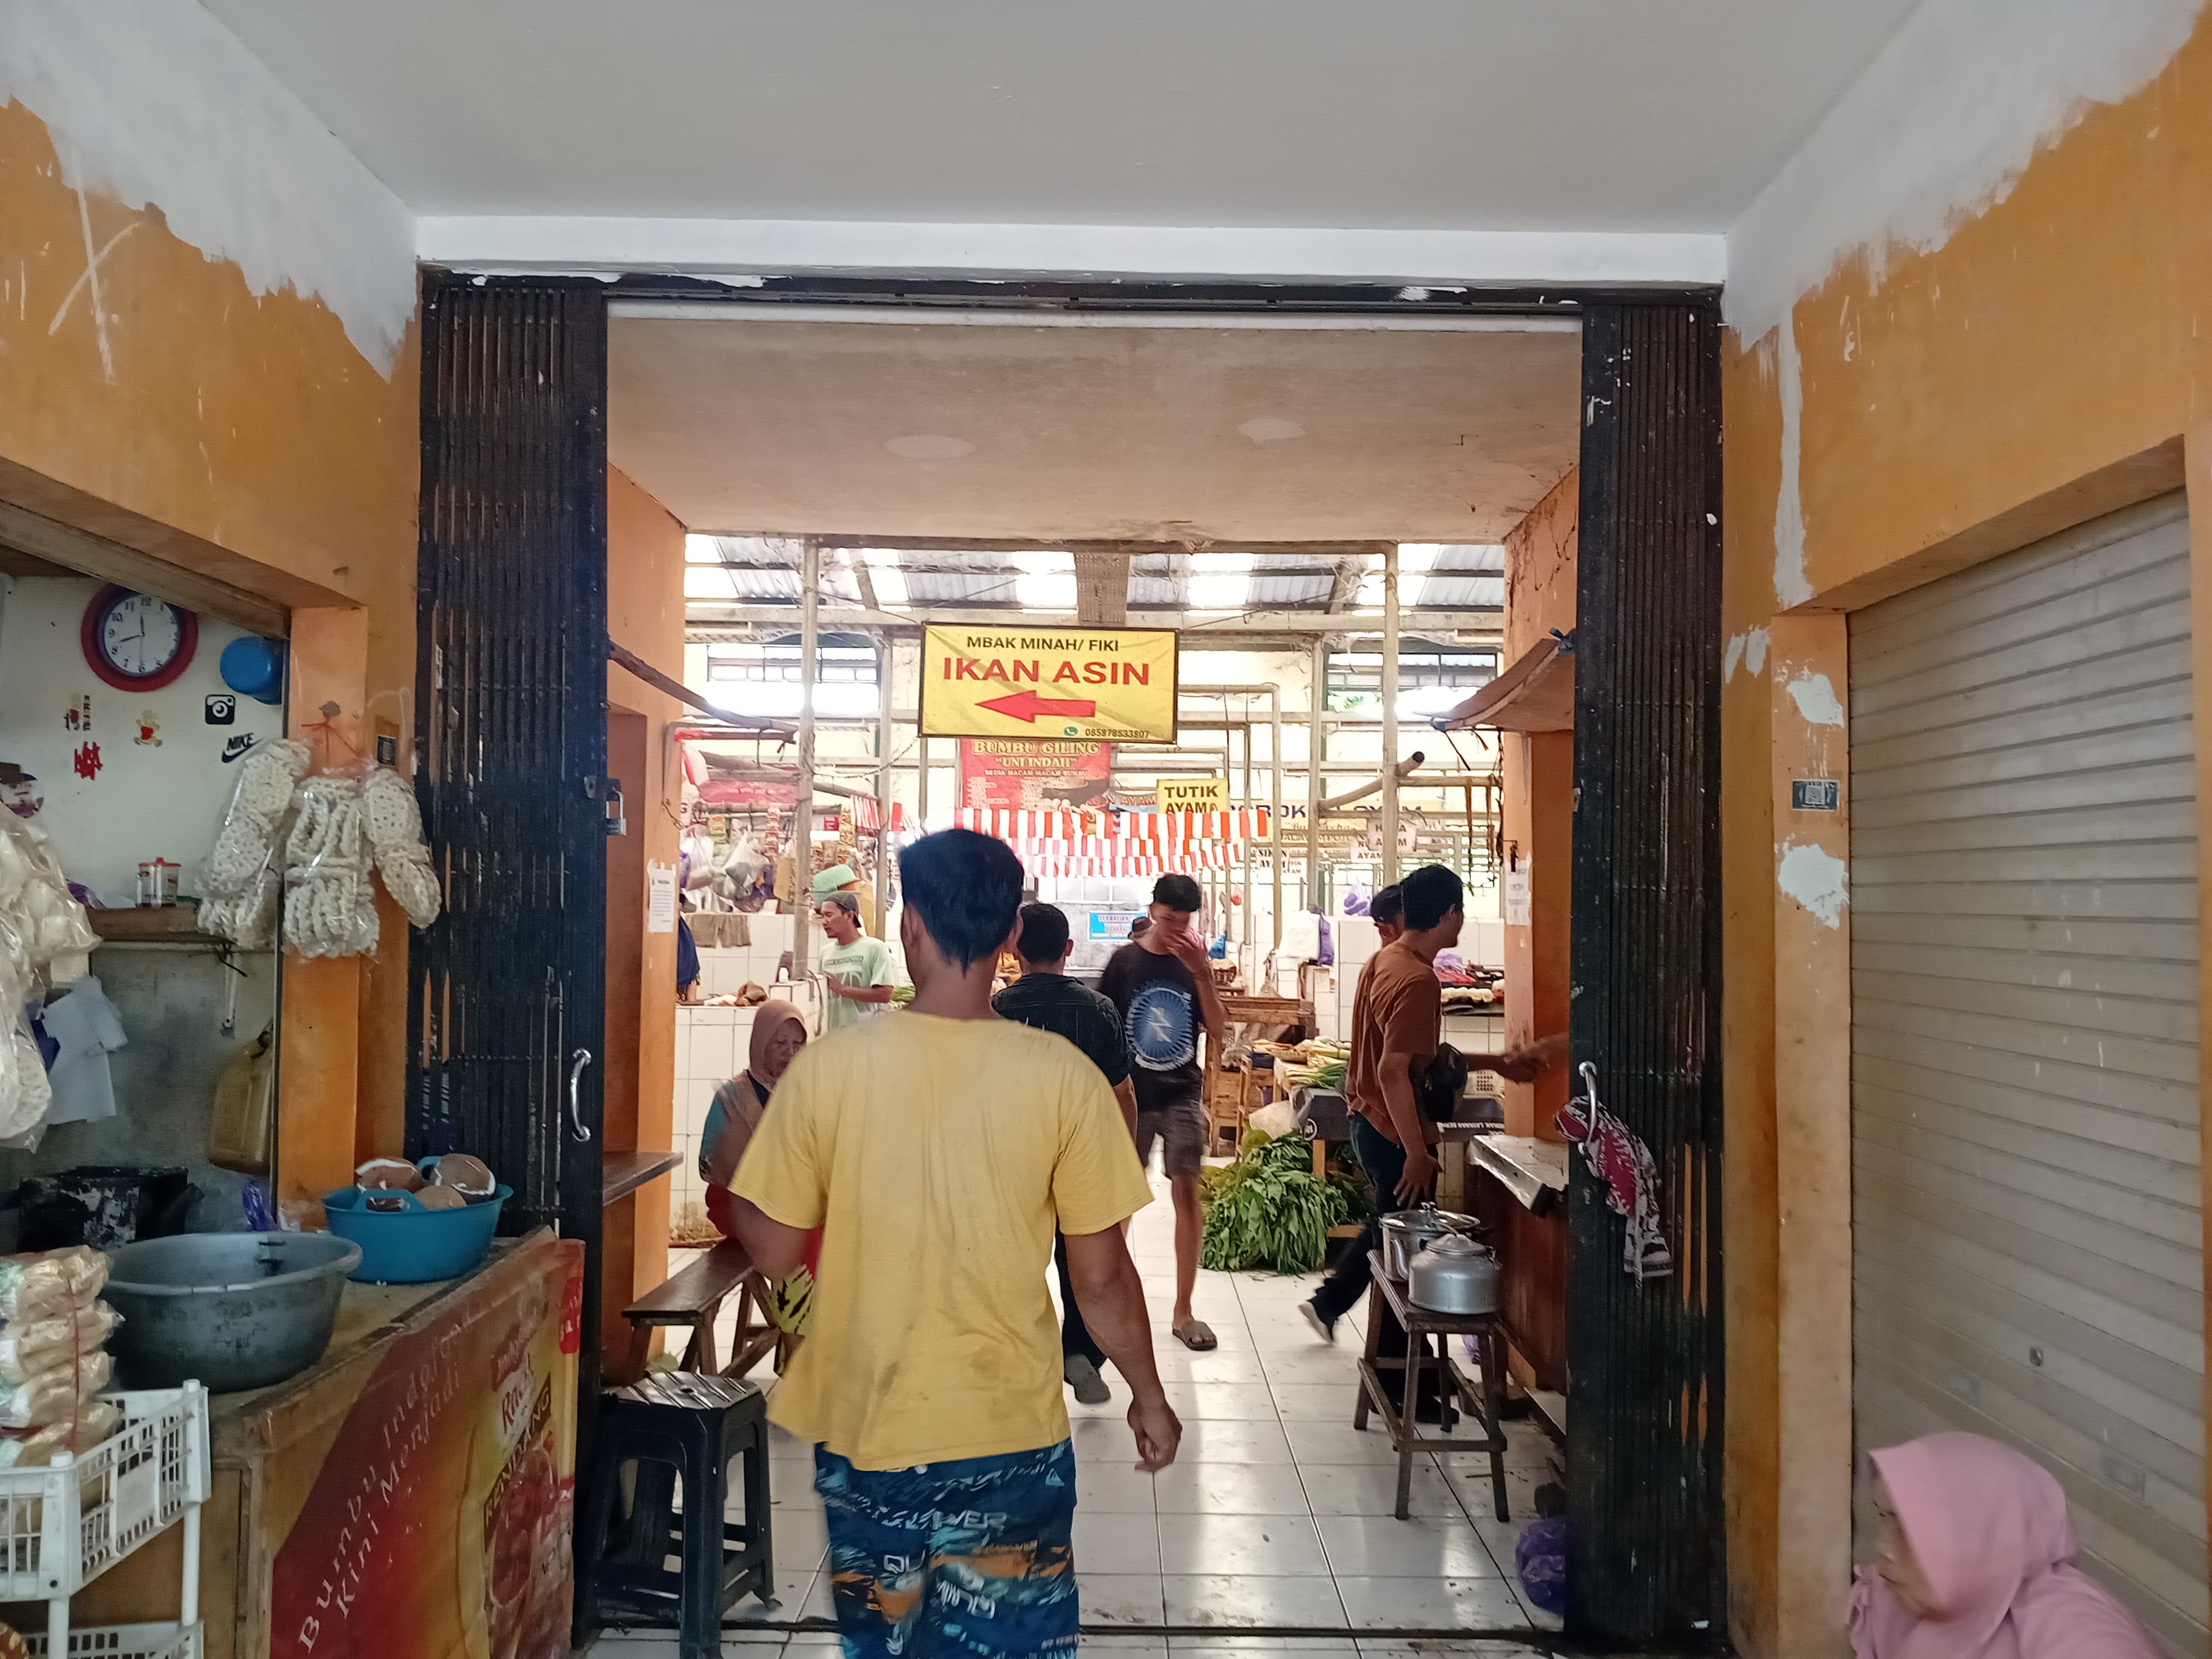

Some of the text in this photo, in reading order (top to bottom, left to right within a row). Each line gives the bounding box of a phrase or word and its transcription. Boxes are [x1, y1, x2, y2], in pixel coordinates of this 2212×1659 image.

[967, 636, 1119, 652] MBAK MINAH/ FIKI
[943, 657, 1149, 686] IKAN ASIN
[226, 732, 254, 751] NIKE
[972, 740, 1101, 756] BUMBU GILING
[1164, 786, 1219, 799] TUTIK
[336, 1512, 379, 1621] Kini
